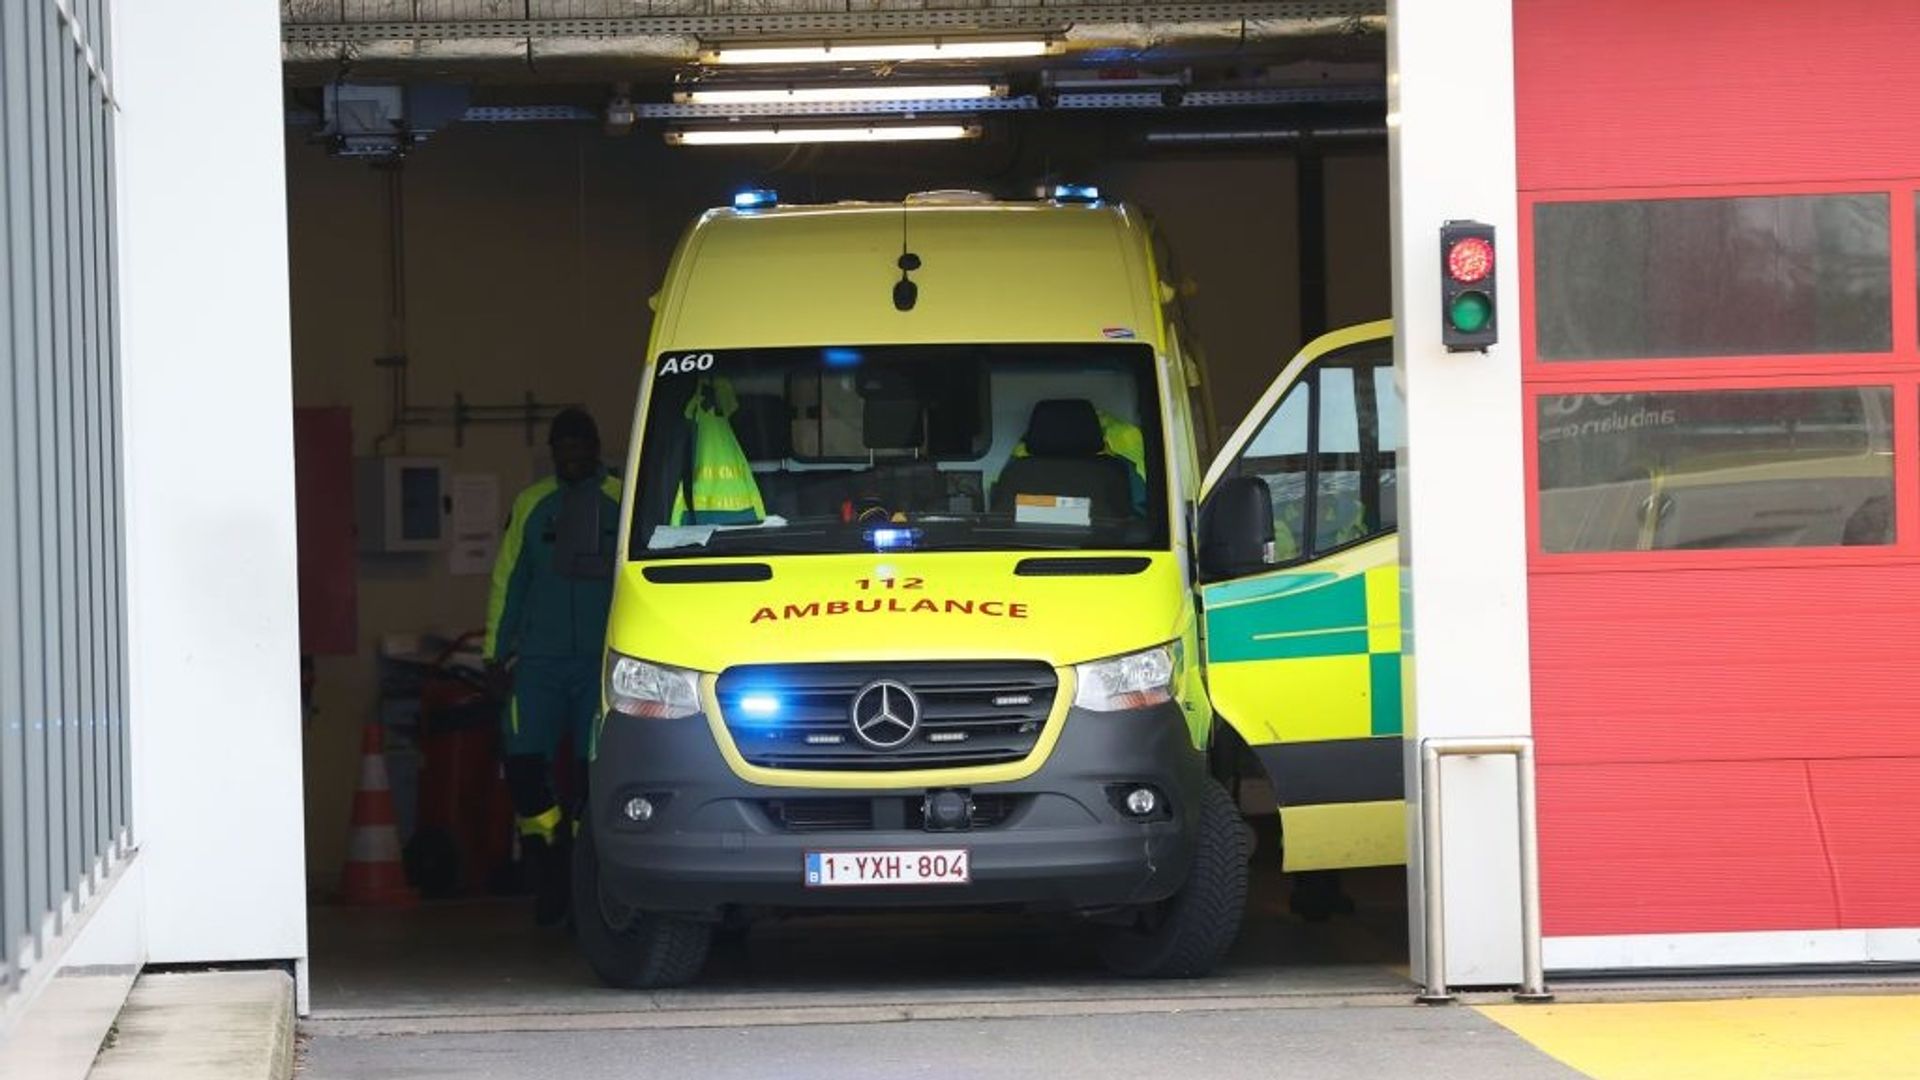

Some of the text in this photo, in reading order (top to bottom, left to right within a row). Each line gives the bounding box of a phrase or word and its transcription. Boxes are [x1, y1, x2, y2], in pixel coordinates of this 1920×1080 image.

[659, 353, 714, 377] A60
[856, 577, 924, 590] 112
[750, 598, 1028, 624] AMBULANCE
